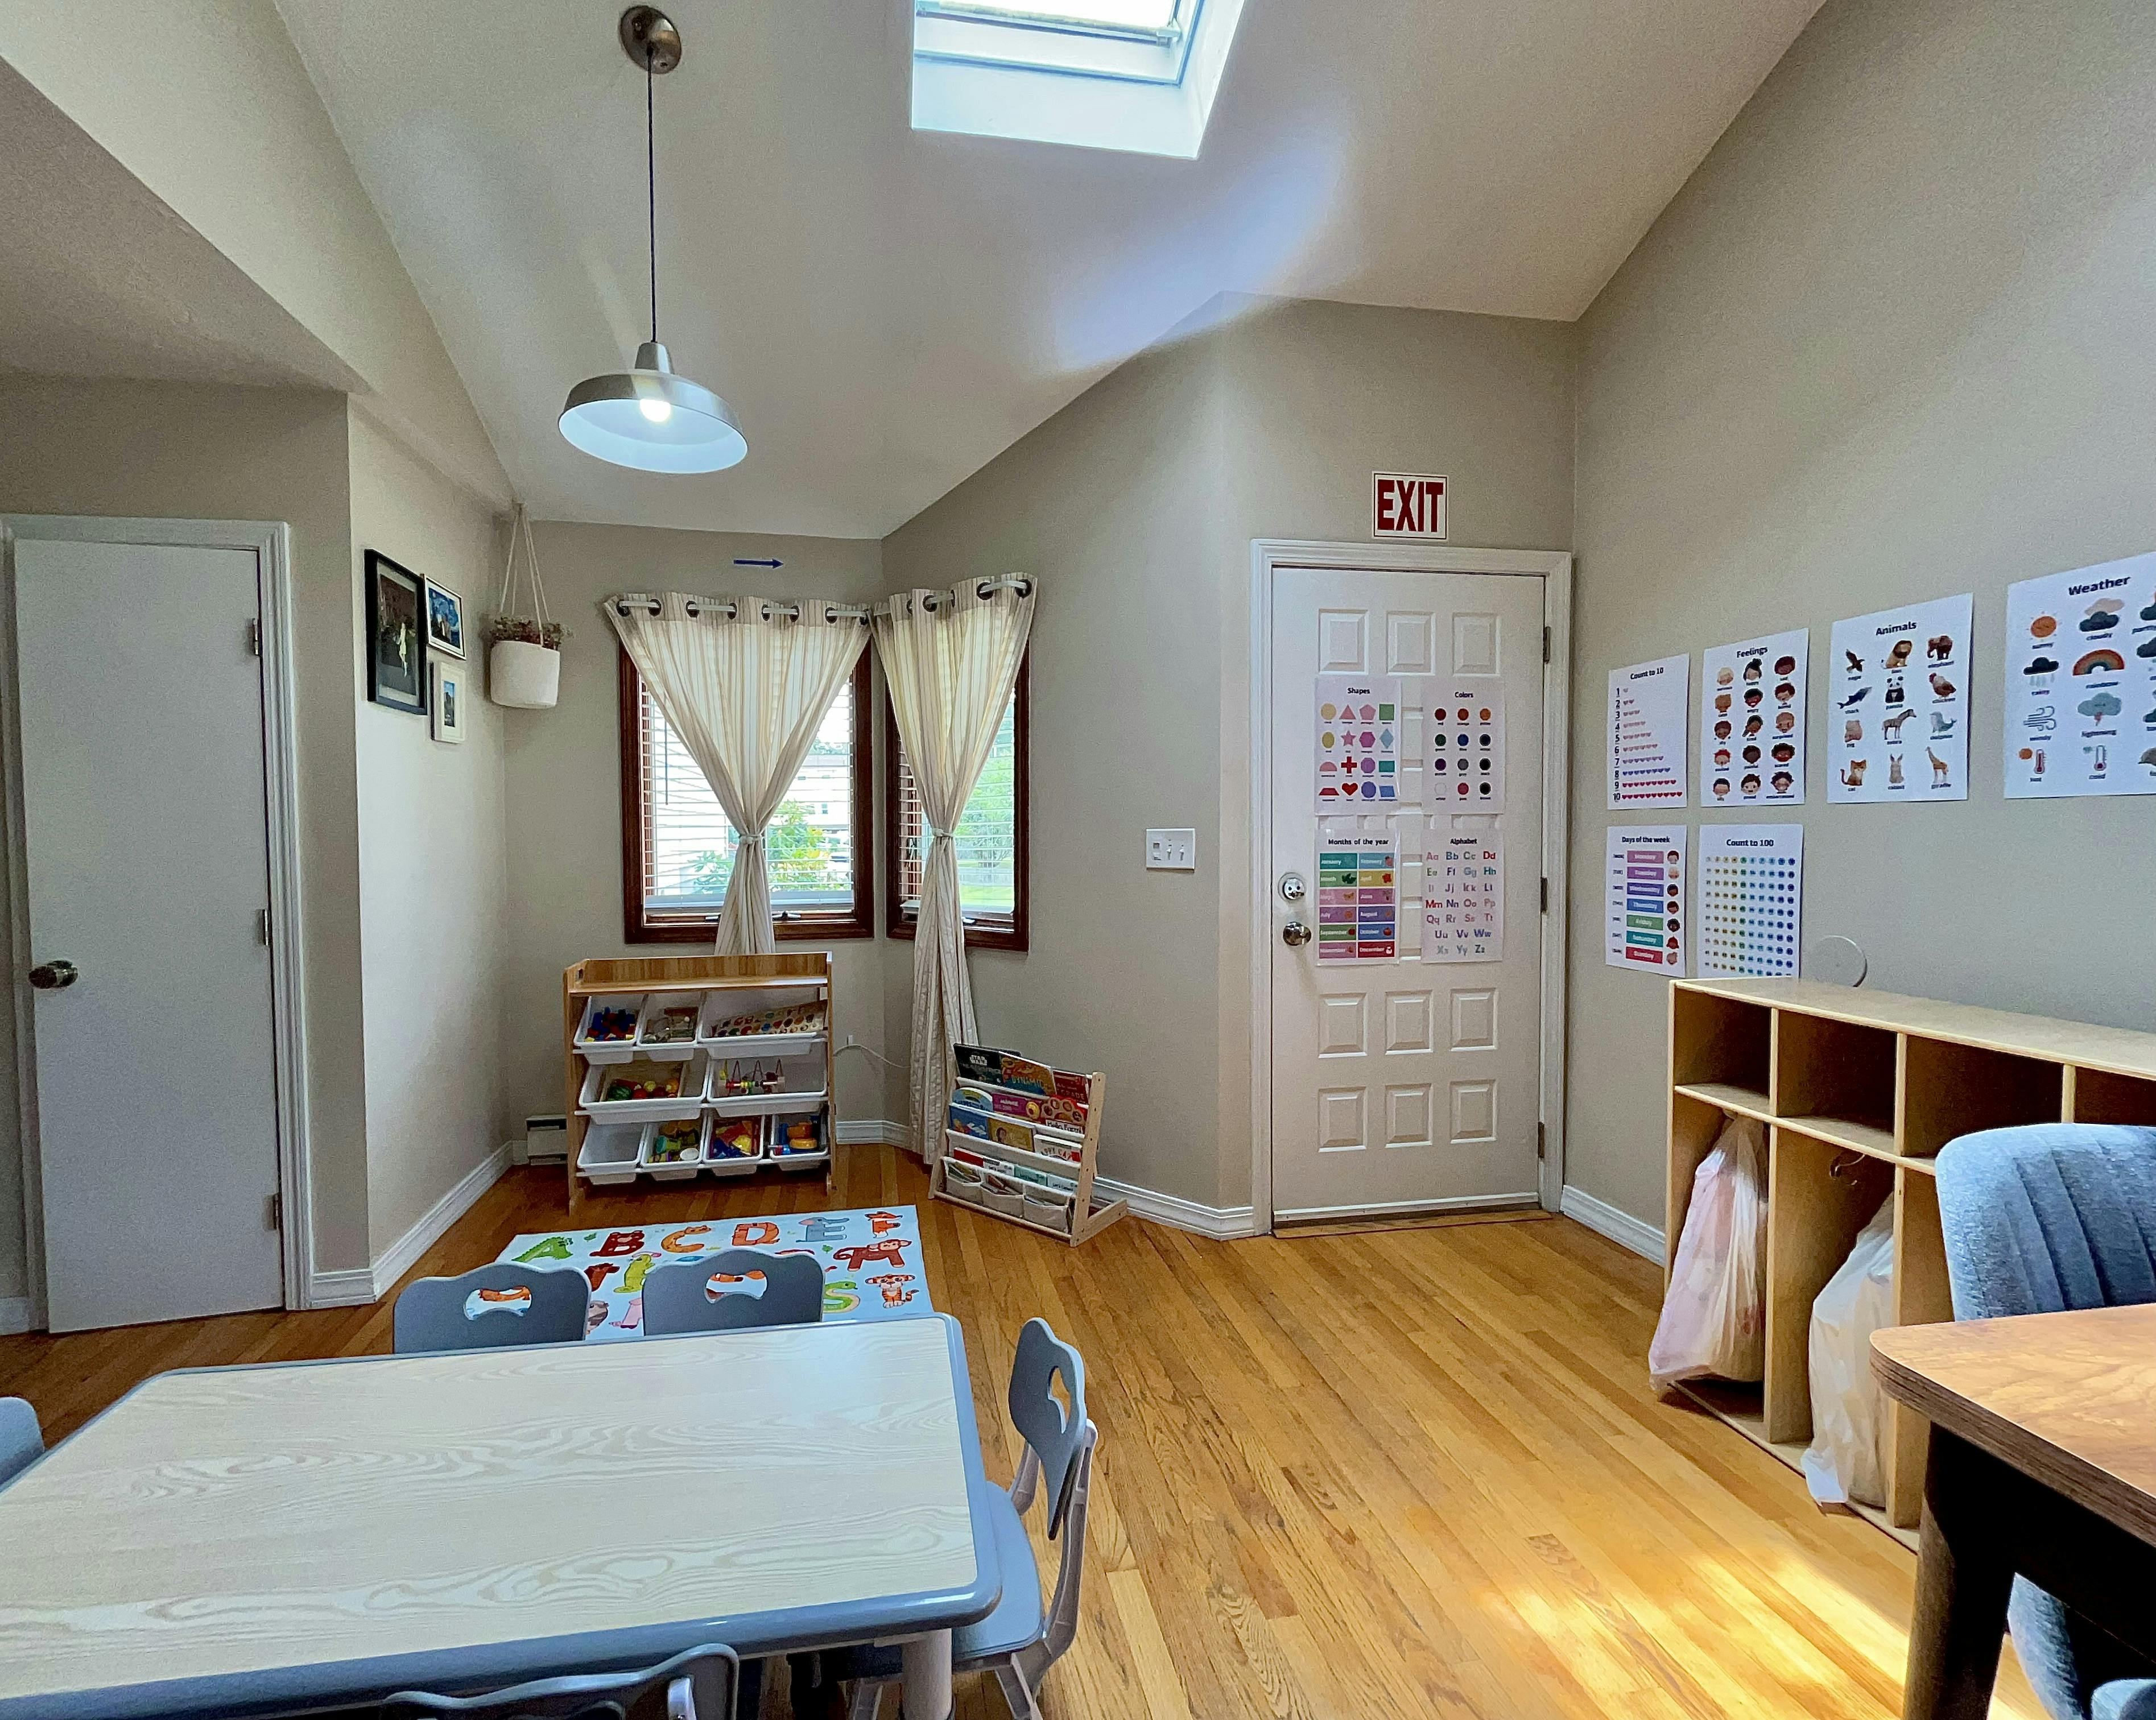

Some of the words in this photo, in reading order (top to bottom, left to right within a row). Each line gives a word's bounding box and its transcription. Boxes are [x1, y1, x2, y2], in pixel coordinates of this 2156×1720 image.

[1378, 479, 1443, 532] EXIT
[2069, 577, 2131, 596] Weather
[1876, 622, 1917, 635] Animals
[1737, 646, 1768, 658] Feelings
[1630, 670, 1648, 680] Count
[1616, 688, 1620, 696] 1
[1614, 770, 1620, 778] 8
[1614, 781, 1619, 790] 9
[1426, 852, 1439, 861] Aa
[1445, 851, 1459, 860] Bb
[1463, 851, 1476, 860] Cc
[1483, 851, 1496, 859] Dd
[1464, 867, 1477, 878] Gg
[1445, 883, 1454, 893] Jj
[1426, 900, 1443, 908] Mm
[1447, 899, 1459, 908] Nn
[1464, 899, 1477, 907] Oo
[1484, 898, 1496, 908] Pp
[1427, 915, 1440, 925] Qq
[1446, 915, 1456, 923] Rr
[1456, 929, 1469, 938] Vv
[1473, 929, 1492, 937] Ww
[1456, 945, 1468, 956] Yy
[1475, 944, 1485, 953] Zz
[589, 1230, 645, 1256] B
[661, 1225, 711, 1253] C
[732, 1222, 780, 1246] D
[796, 1217, 849, 1242] E
